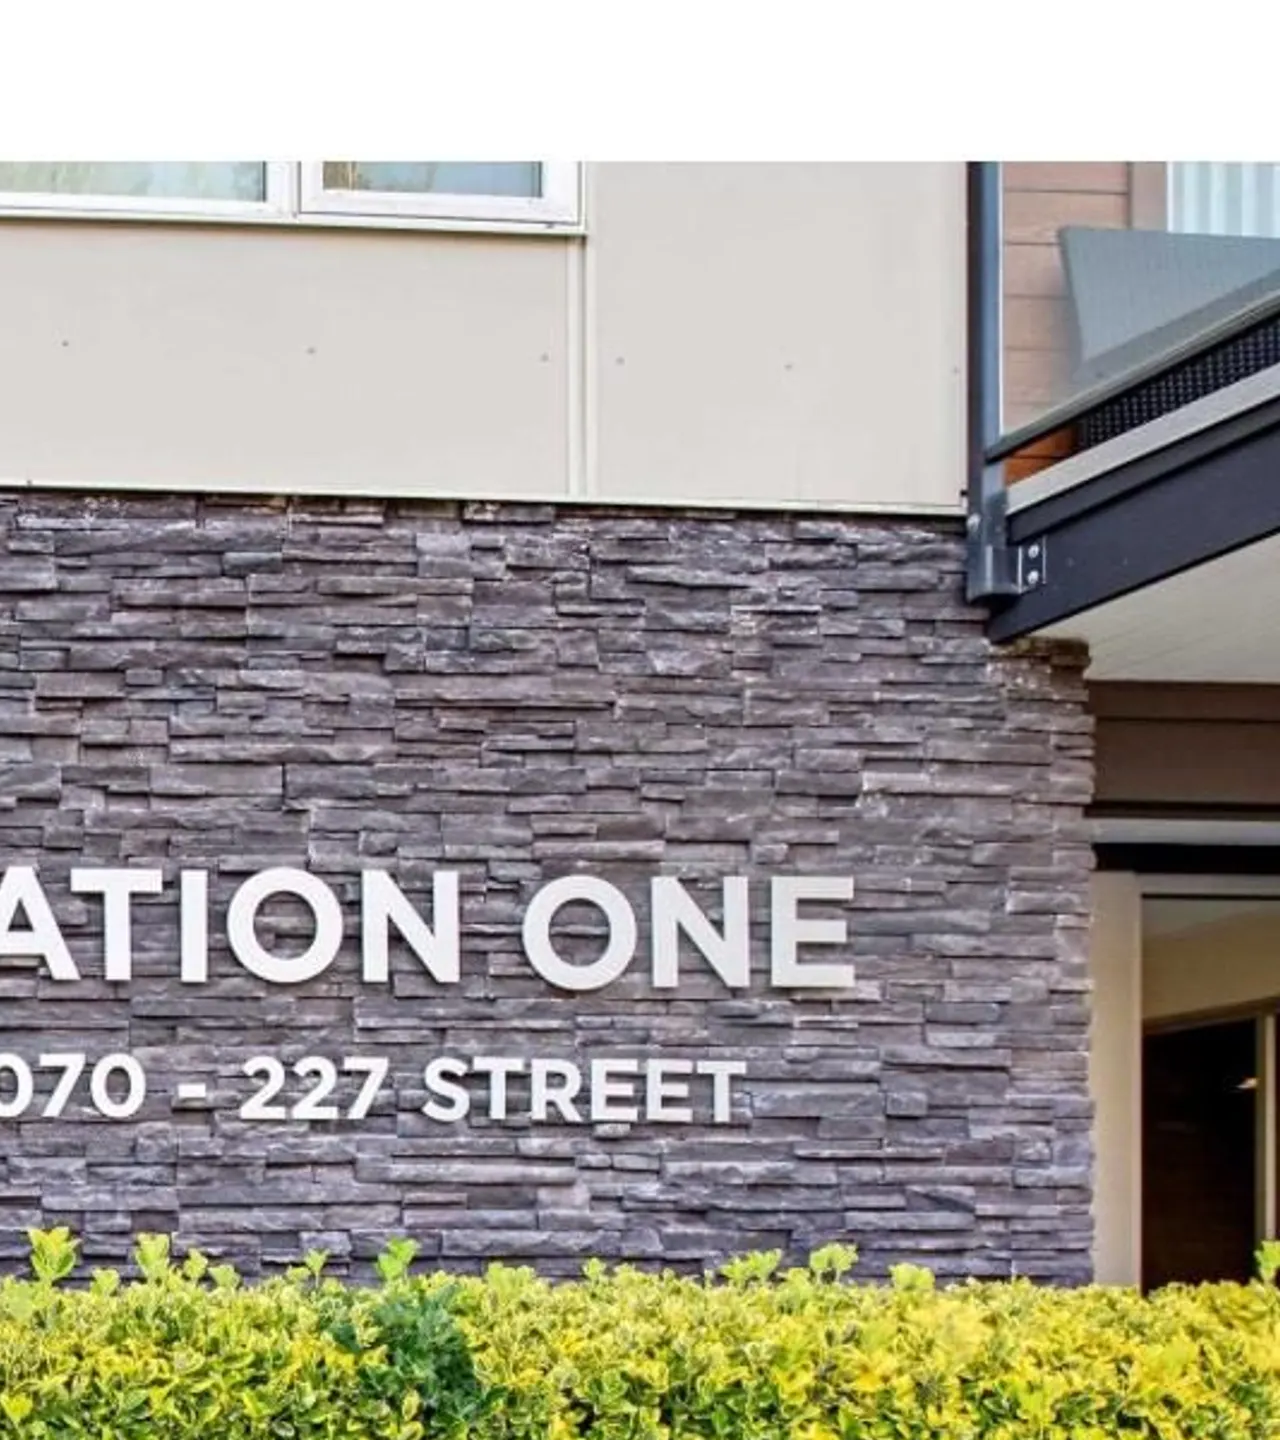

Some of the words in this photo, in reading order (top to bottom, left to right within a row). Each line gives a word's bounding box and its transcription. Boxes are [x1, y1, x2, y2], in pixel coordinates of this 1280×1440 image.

[522, 875, 855, 991] ONE
[177, 1082, 207, 1099] -
[240, 1055, 389, 1122] 227
[421, 1056, 747, 1123] STREET
